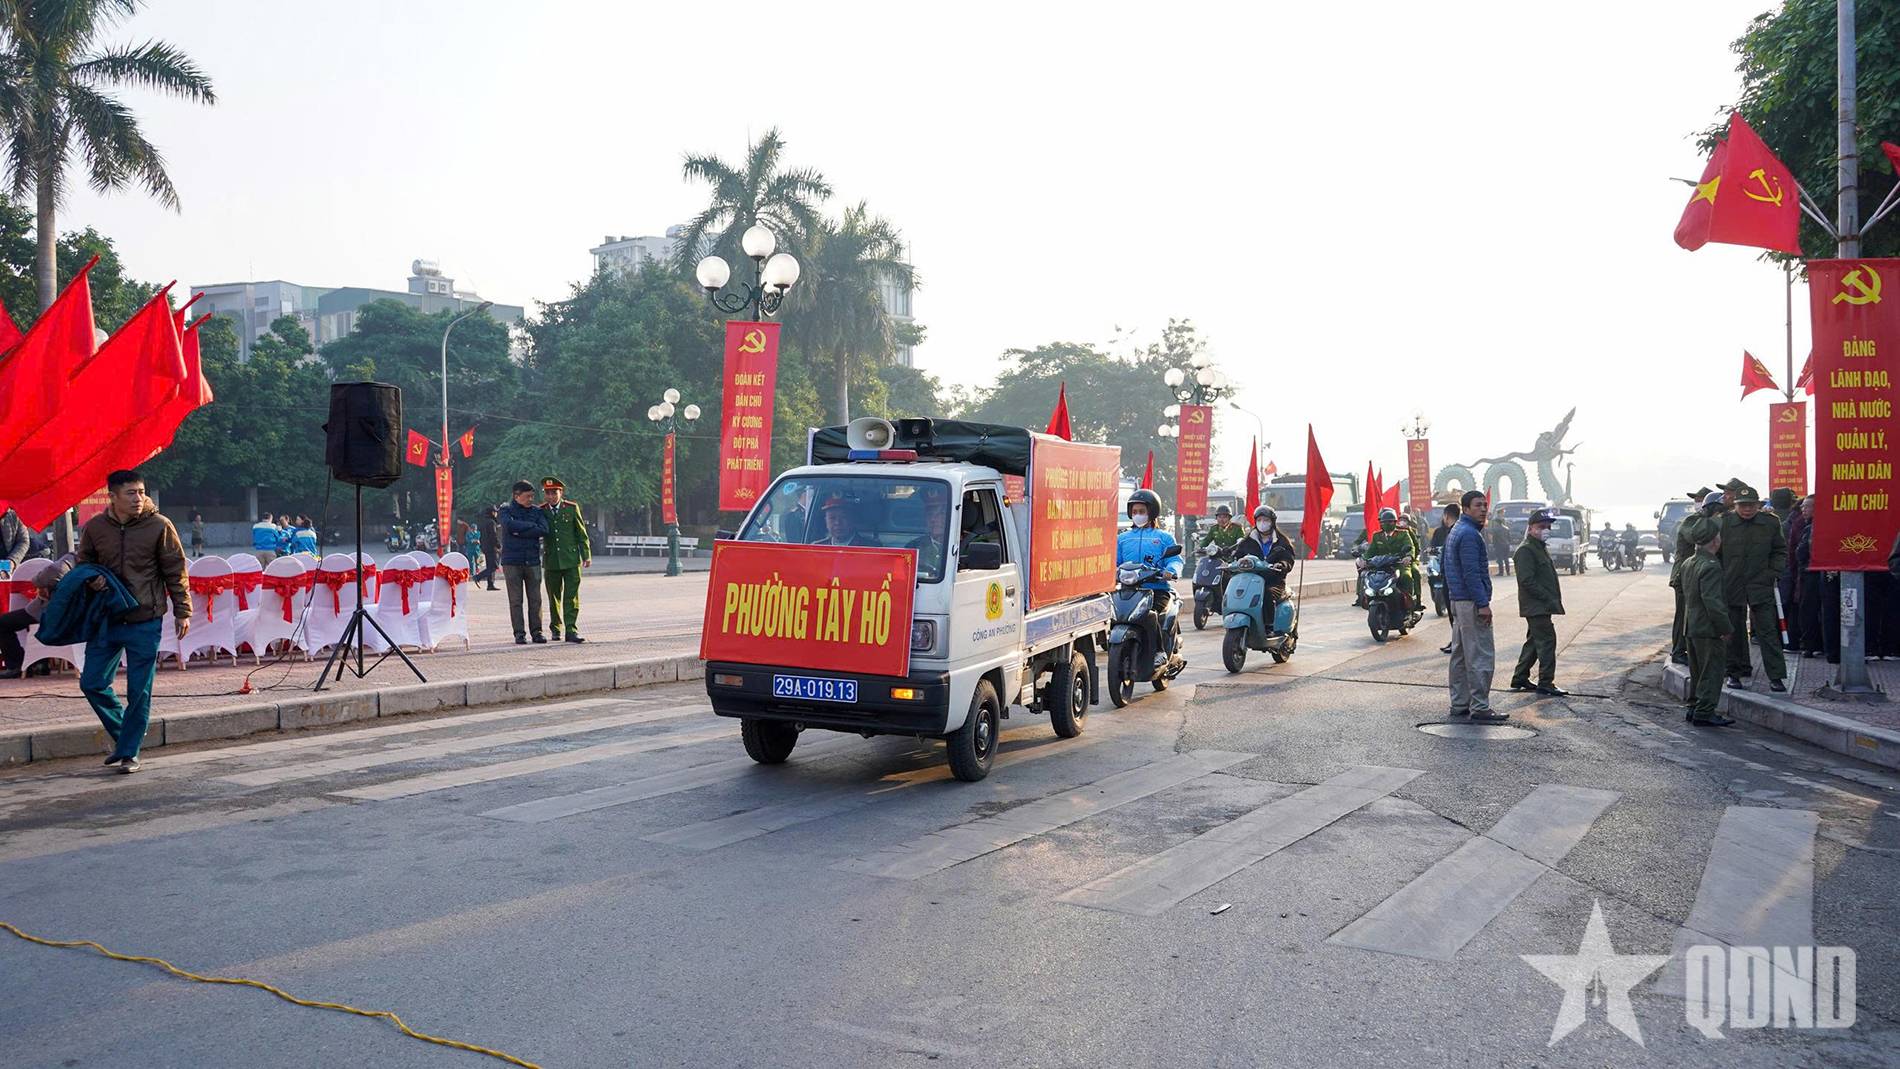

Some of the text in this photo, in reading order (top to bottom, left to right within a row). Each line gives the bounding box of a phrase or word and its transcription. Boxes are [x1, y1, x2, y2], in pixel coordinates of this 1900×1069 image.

[1843, 335, 1876, 357] ĐẢNG
[735, 370, 765, 386] ĐOÀN KẾT
[1830, 368, 1891, 391] LÃNH ĐẠO,
[735, 391, 763, 407] DÂN CHỦ
[1832, 397, 1891, 419] NHÀ NƯỚC
[742, 415, 763, 428] CƯƠNG
[733, 435, 759, 451] ĐỘT PHÁ
[1836, 427, 1888, 451] QUẢN LÝ,
[727, 454, 764, 471] PHÁT TRIỂN!
[1832, 460, 1892, 480] NHÂN DÂN
[1045, 464, 1068, 489] PHƯỜNG
[1069, 466, 1079, 489] TÂY
[1080, 464, 1087, 489] HỒ
[1087, 466, 1101, 492] QUYẾT
[1048, 492, 1061, 519] ĐẢM
[1062, 493, 1072, 519] BẢO
[1074, 496, 1085, 522] TRẬT
[1086, 499, 1093, 523] TỰ
[1833, 489, 1889, 511] LÀM CHỦ!
[1052, 526, 1059, 554] VỆ
[1060, 530, 1072, 550] SINH
[1073, 525, 1084, 548] MÔI
[1039, 547, 1112, 585] VỆ SINH AN TOÀN THỰC PHẨM
[722, 572, 892, 646] PHƯỜNG TÂY HỒ
[972, 621, 1016, 641] CÔNG AN PHƯỜNG
[776, 677, 855, 700] 29A-019.13
